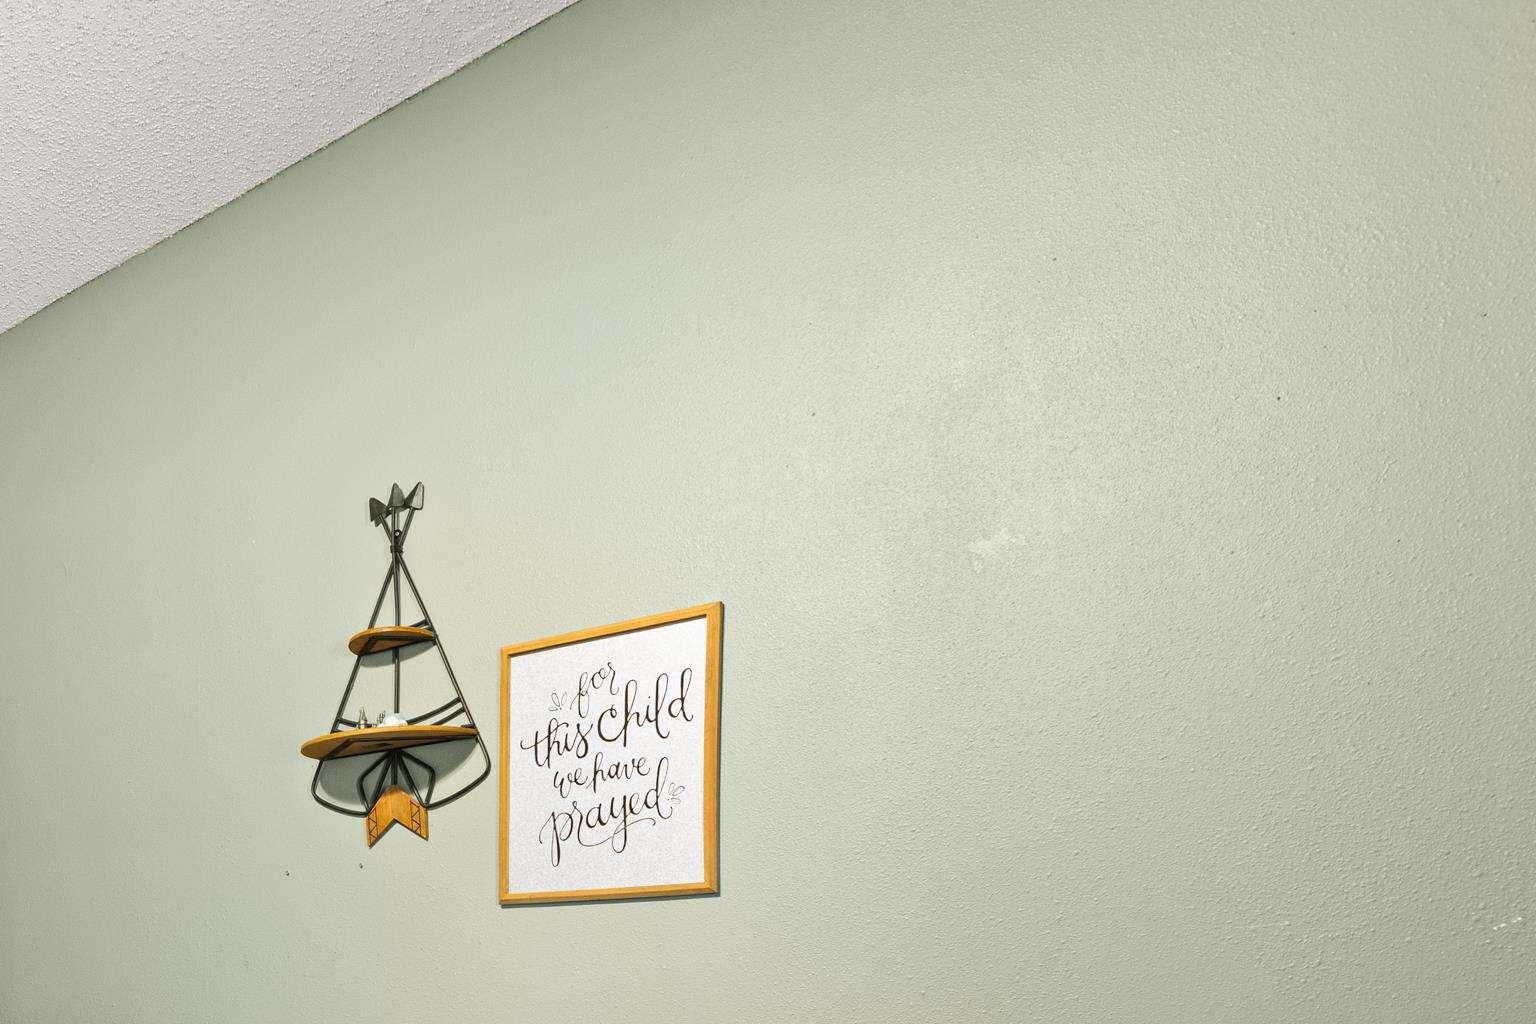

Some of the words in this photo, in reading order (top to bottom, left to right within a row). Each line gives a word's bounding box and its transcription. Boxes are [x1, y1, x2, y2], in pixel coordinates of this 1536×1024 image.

[569, 661, 619, 719] for
[520, 717, 595, 769] this
[553, 767, 590, 799] we
[586, 751, 651, 794] have
[538, 756, 673, 868] prayed
